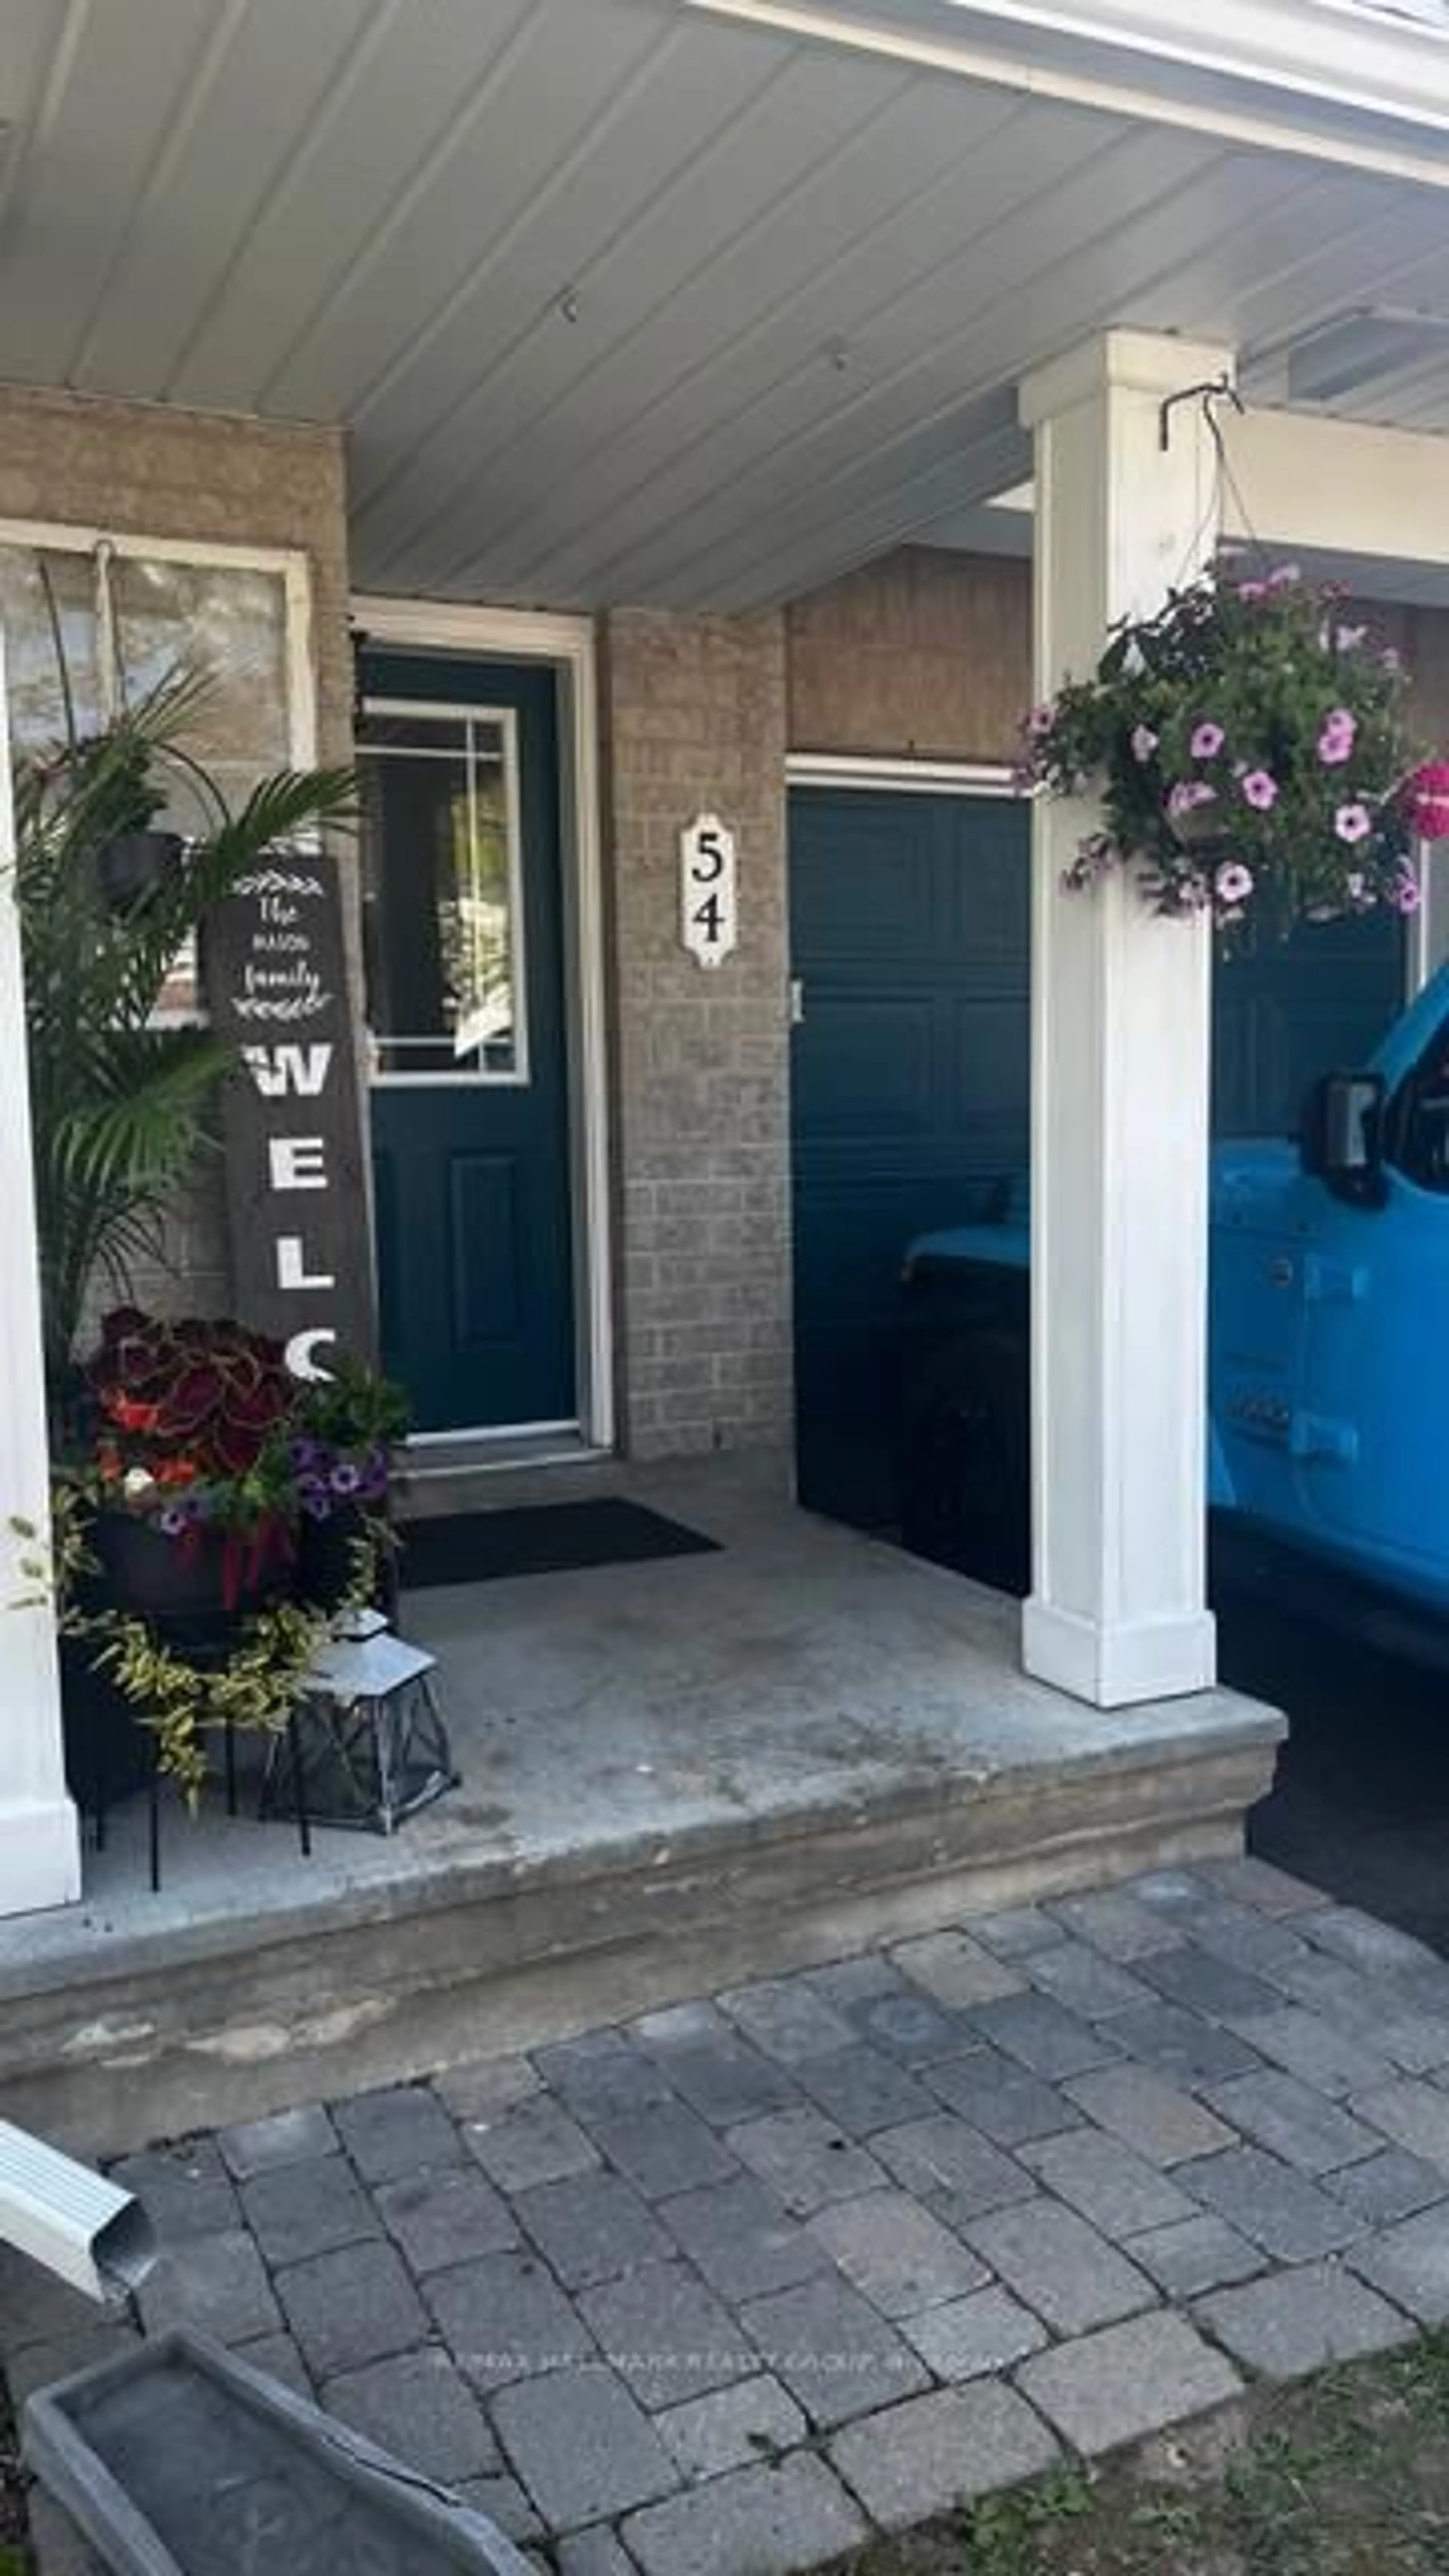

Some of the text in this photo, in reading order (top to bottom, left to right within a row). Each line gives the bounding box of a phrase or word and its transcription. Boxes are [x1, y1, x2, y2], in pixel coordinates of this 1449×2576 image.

[692, 832, 726, 943] 54
[261, 896, 298, 926] The
[245, 960, 320, 1002] family
